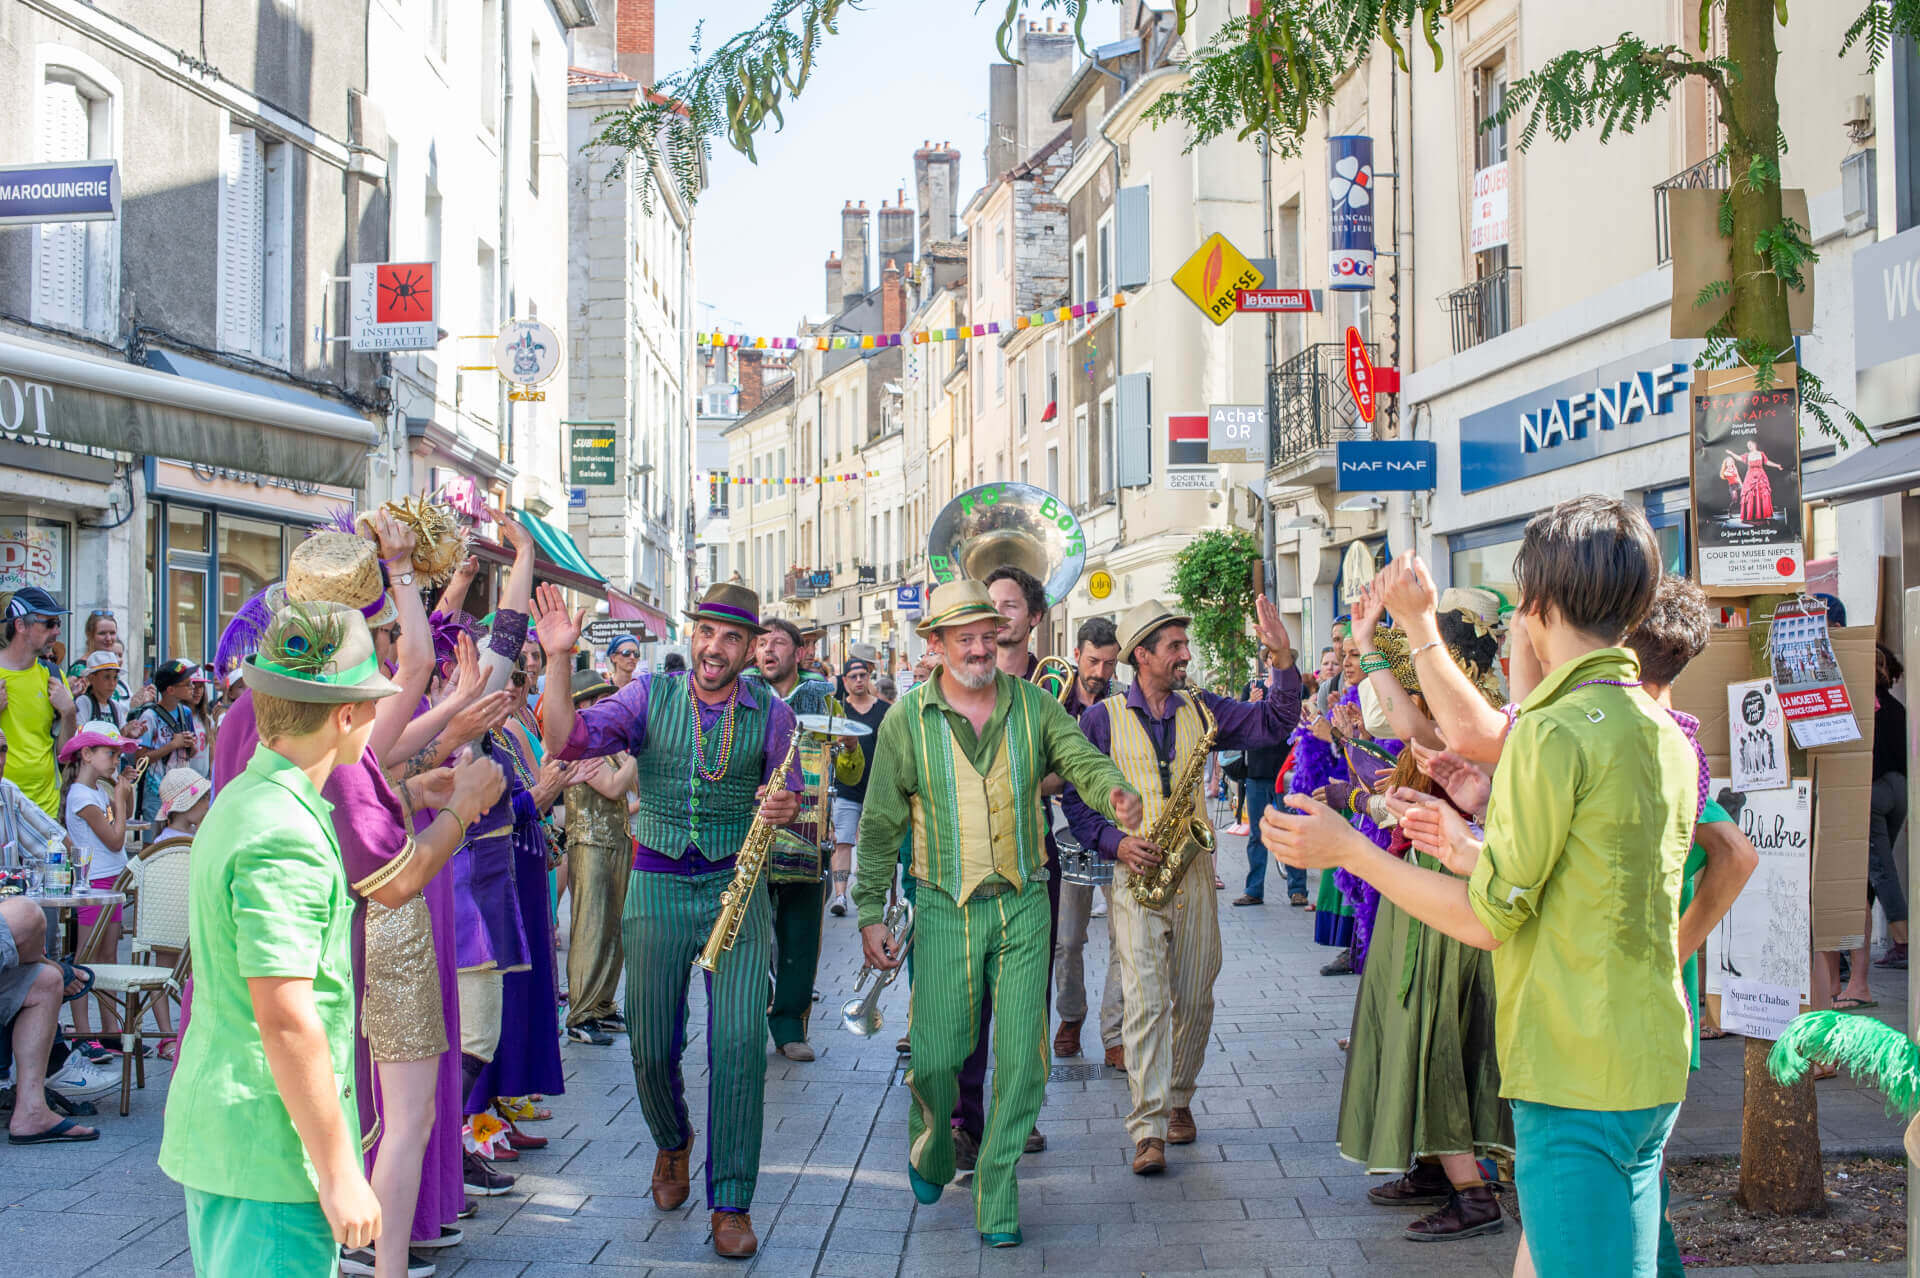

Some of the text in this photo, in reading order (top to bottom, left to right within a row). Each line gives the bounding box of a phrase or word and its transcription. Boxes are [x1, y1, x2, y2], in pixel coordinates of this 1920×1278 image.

[0, 181, 108, 200] MAROQUINERIE
[1211, 269, 1257, 318] PRESSE
[361, 327, 425, 337] INSTITUT
[357, 339, 370, 348] de
[1351, 346, 1371, 405] TABAC
[0, 375, 54, 436] OT
[1214, 408, 1264, 424] Achat
[1226, 424, 1251, 439] OR
[573, 438, 614, 448] SUBWAY
[1342, 461, 1427, 472] NAF NAF
[578, 470, 607, 478] Salades
[1706, 552, 1729, 560] COUR
[1729, 550, 1740, 559] DU
[1781, 696, 1791, 707] LA
[1744, 808, 1807, 849] Palabre
[1730, 988, 1790, 1007] Square Chabas
[1745, 1023, 1771, 1037] 22H10
